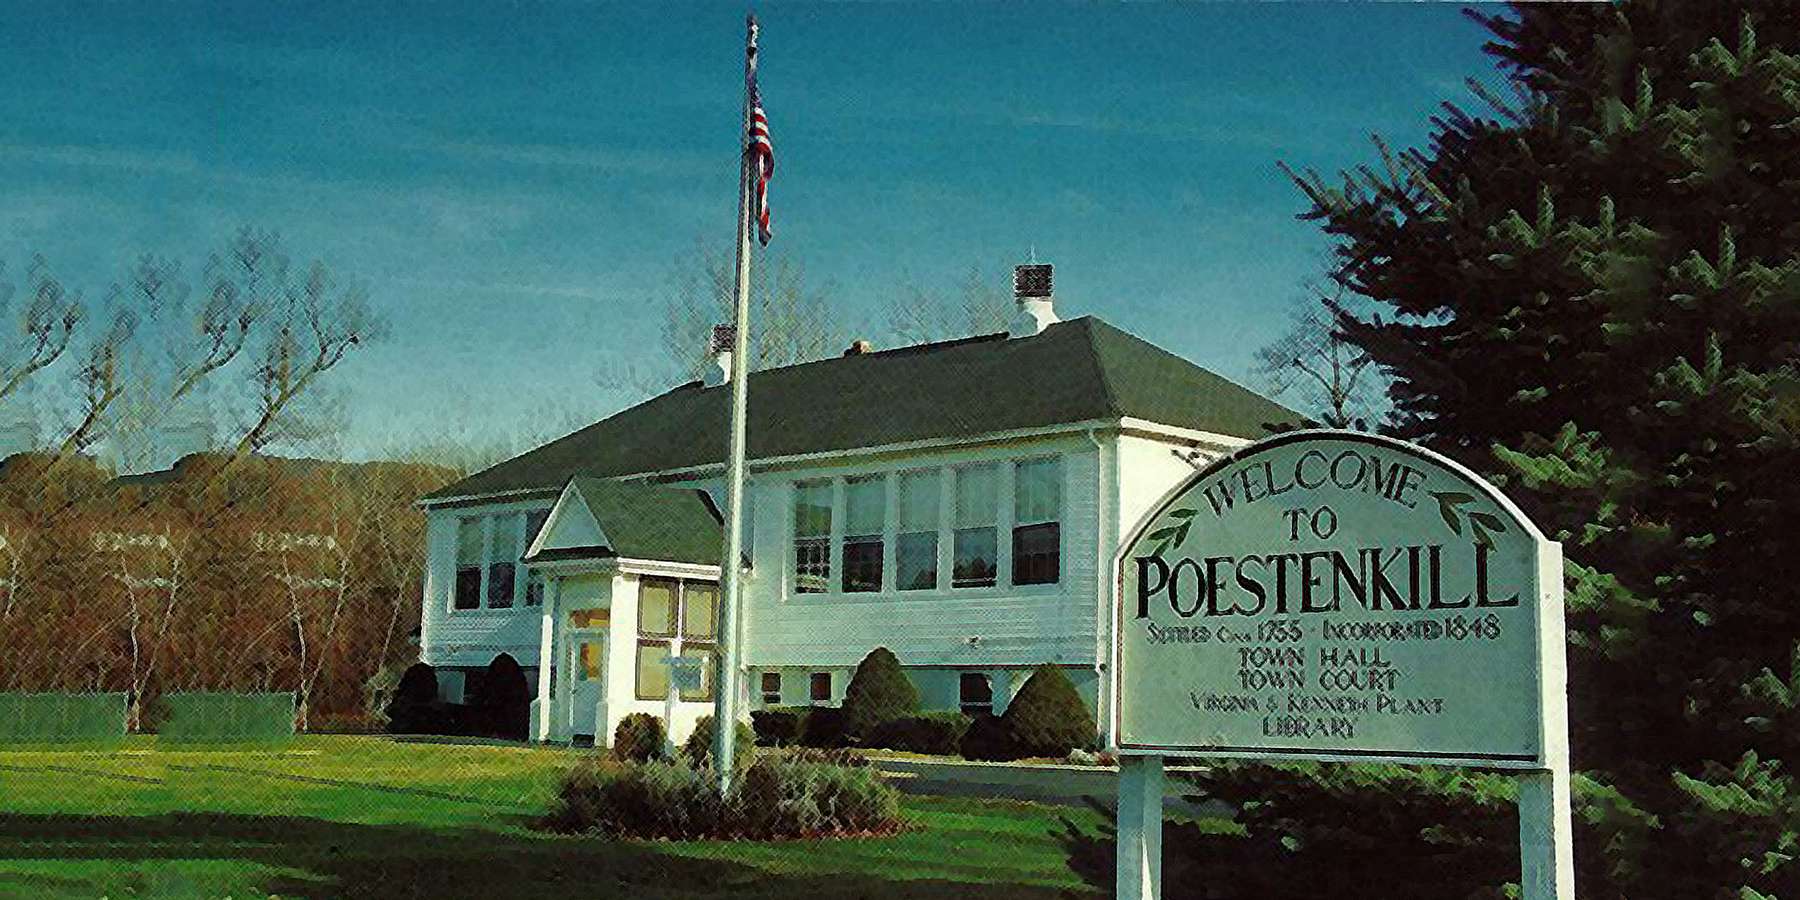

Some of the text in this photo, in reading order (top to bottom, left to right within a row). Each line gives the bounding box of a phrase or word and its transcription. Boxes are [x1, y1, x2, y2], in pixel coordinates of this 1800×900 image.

[1203, 450, 1428, 518] WELCOME
[1283, 504, 1338, 541] TO
[1134, 543, 1519, 619] POESTENKILL
[1257, 619, 1303, 643] 1755
[1445, 613, 1501, 640] 1848
[1239, 647, 1391, 668] TOWN HALL
[1239, 669, 1401, 691] TOWN COURT
[1376, 692, 1445, 715] PLANT
[1262, 715, 1358, 739] LIBRARY
